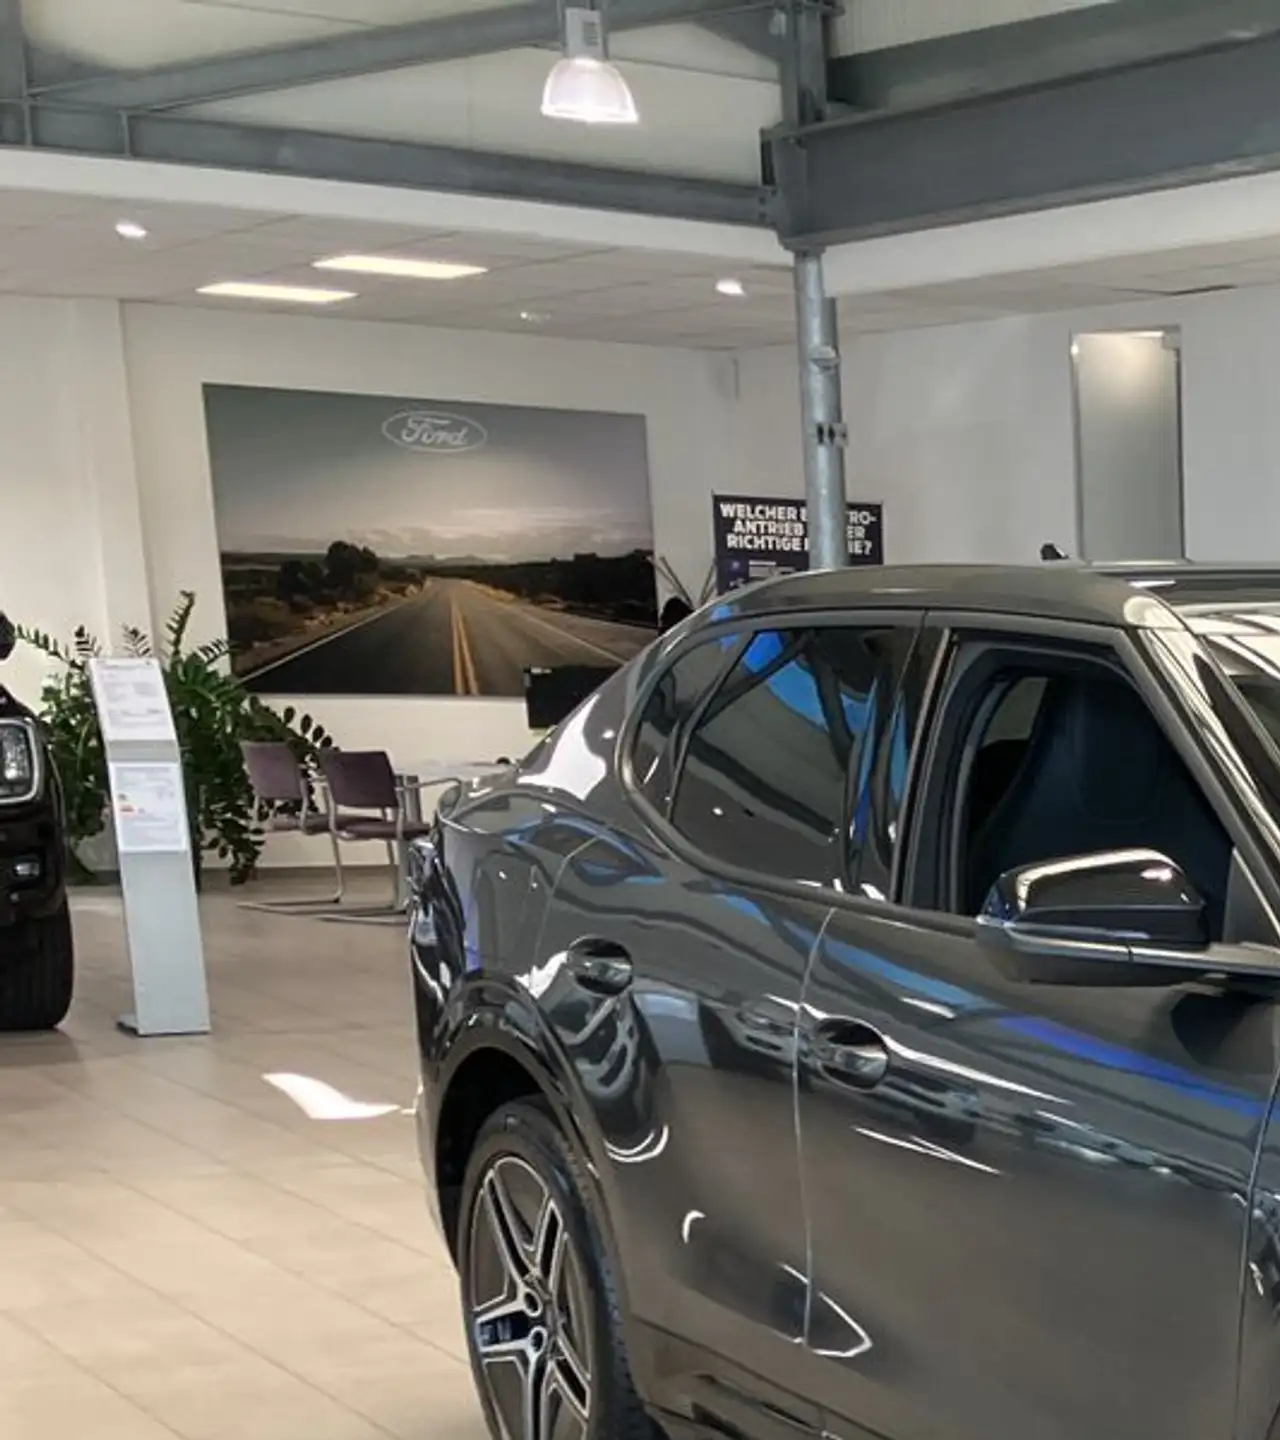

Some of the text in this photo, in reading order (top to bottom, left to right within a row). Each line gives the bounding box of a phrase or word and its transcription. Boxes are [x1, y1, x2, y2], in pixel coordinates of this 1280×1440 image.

[402, 418, 469, 445] Ford
[720, 503, 797, 520] WELCHER
[734, 520, 804, 536] ANTRIEB
[727, 534, 802, 551] RICHTIGE
